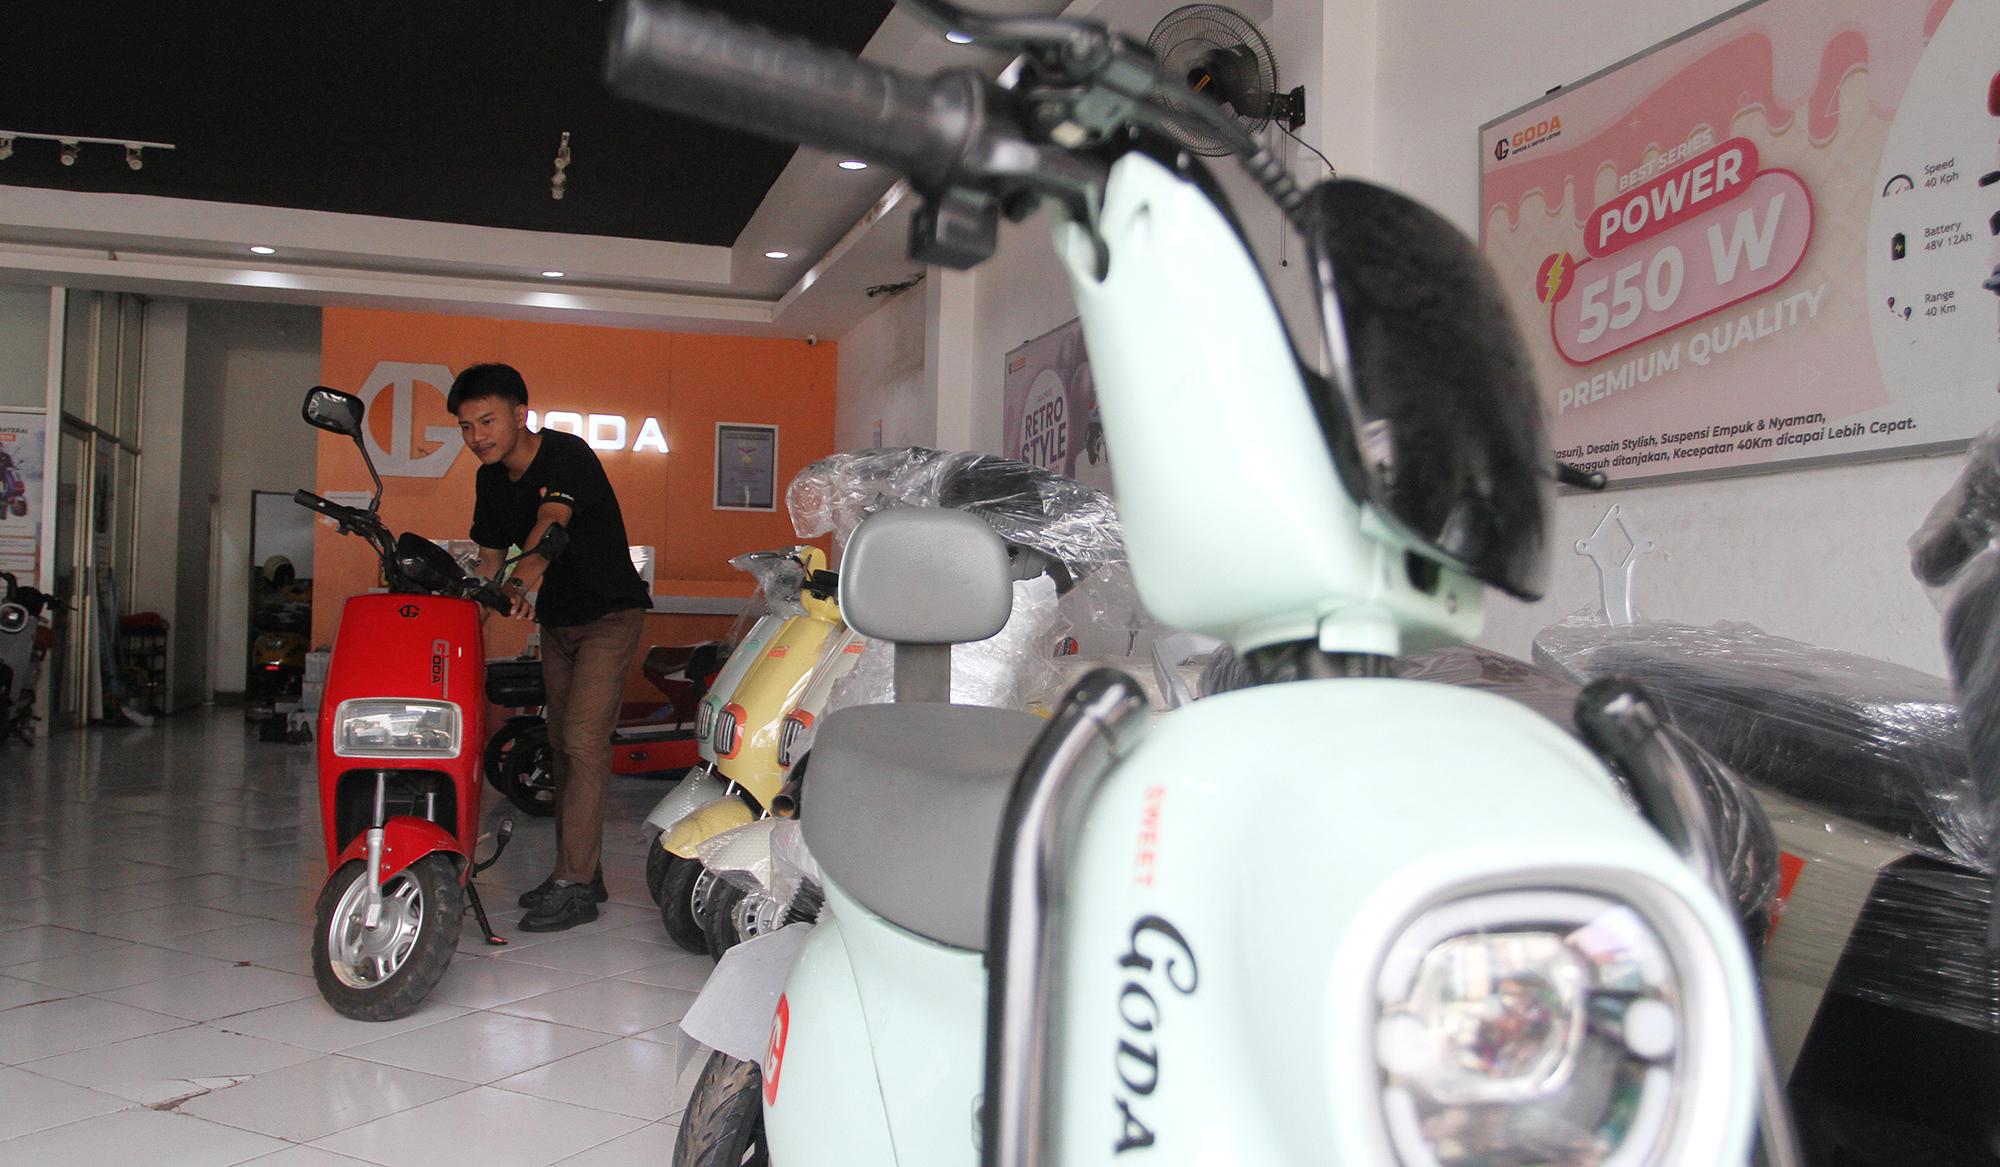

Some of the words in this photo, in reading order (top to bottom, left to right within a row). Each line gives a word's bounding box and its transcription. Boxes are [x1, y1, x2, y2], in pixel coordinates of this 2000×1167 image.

[1512, 116, 1561, 147] GODA
[1618, 159, 1656, 192] BEST
[1659, 128, 1712, 168] SERIES
[1925, 158, 1954, 175] Speed
[1925, 177, 1936, 188] 40
[1941, 172, 1959, 185] Kph
[1599, 149, 1743, 247] POWER
[1924, 221, 1962, 238] Battery
[1924, 239, 1944, 252] 48V
[1948, 232, 1972, 246] 12Ah
[1576, 244, 1685, 345] 550
[1707, 193, 1786, 286] W
[1925, 290, 1954, 303] Range
[1925, 307, 1937, 316] 40
[1941, 304, 1955, 314] Km
[1558, 343, 1680, 414] PREMIUM
[1688, 285, 1825, 366] QUALITY
[526, 409, 670, 454] ODA
[1026, 397, 1063, 439] RETRO
[1586, 440, 1620, 455] Desain
[1621, 435, 1659, 450] Stylish,
[1660, 426, 1710, 445] Suspensi
[1712, 420, 1754, 438] Empuk
[1756, 419, 1766, 430] &
[1768, 412, 1826, 431] Nyaman,
[1022, 422, 1066, 466] STYLE
[1612, 451, 1670, 468] ditanjakan,
[1673, 440, 1734, 460] Kecepatan
[1736, 436, 1772, 451] 40Km
[1776, 428, 1825, 446] dicapai
[1828, 422, 1865, 440] Lebih
[1869, 417, 1917, 435] Cepat.
[431, 638, 450, 685] GODA
[1136, 786, 1165, 886] SWEET
[1115, 915, 1198, 1155] GODA
